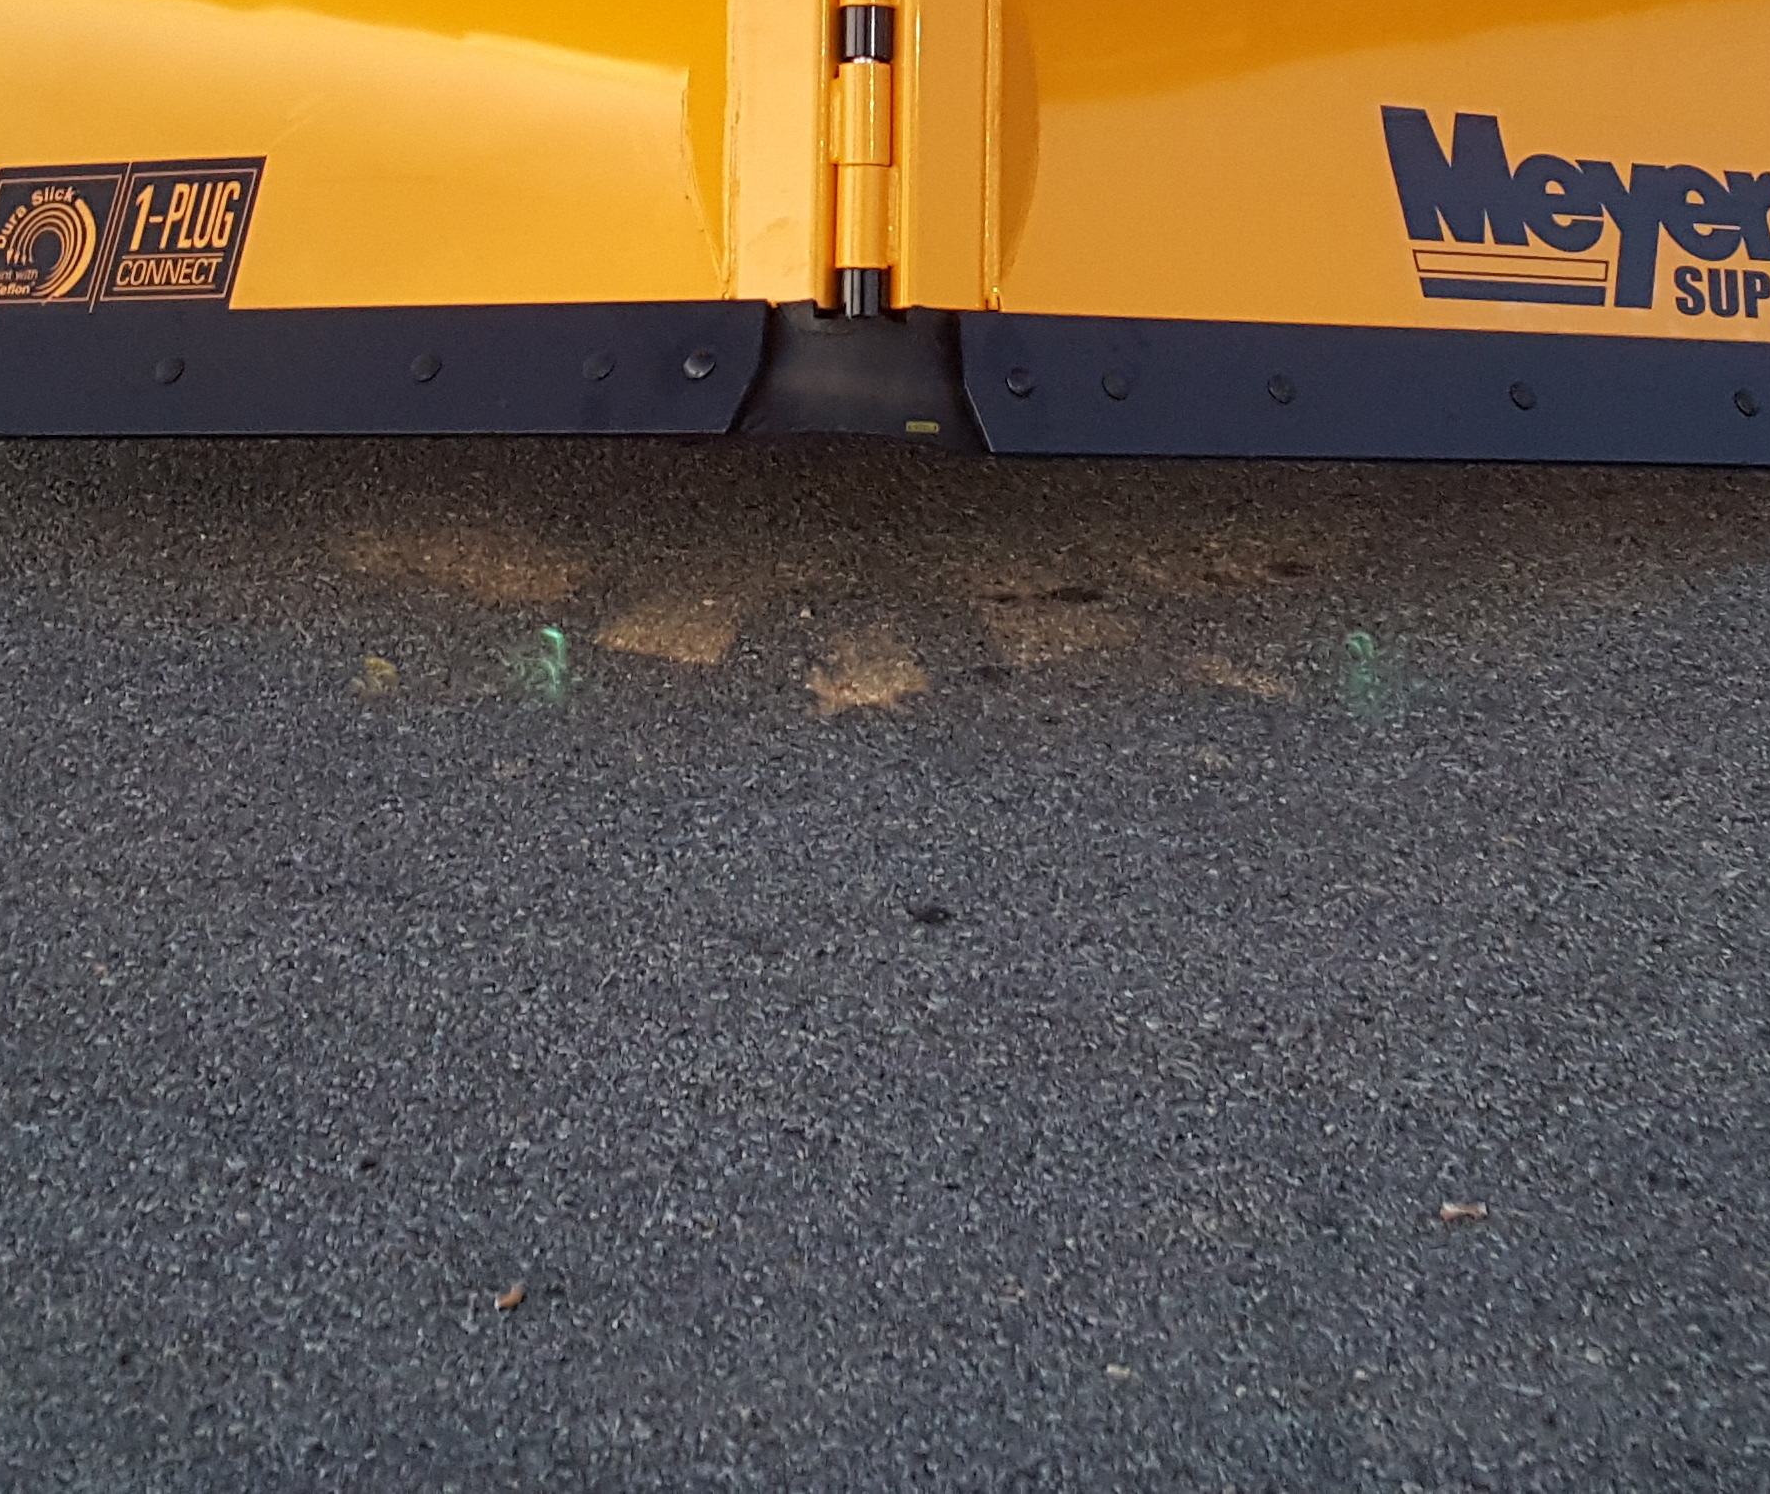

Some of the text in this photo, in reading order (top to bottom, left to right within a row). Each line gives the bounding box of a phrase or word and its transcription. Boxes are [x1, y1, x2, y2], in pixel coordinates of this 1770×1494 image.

[31, 185, 77, 207] Slick
[129, 180, 242, 252] 1-PLUG
[15, 268, 39, 281] with
[116, 257, 223, 286] CONNECT
